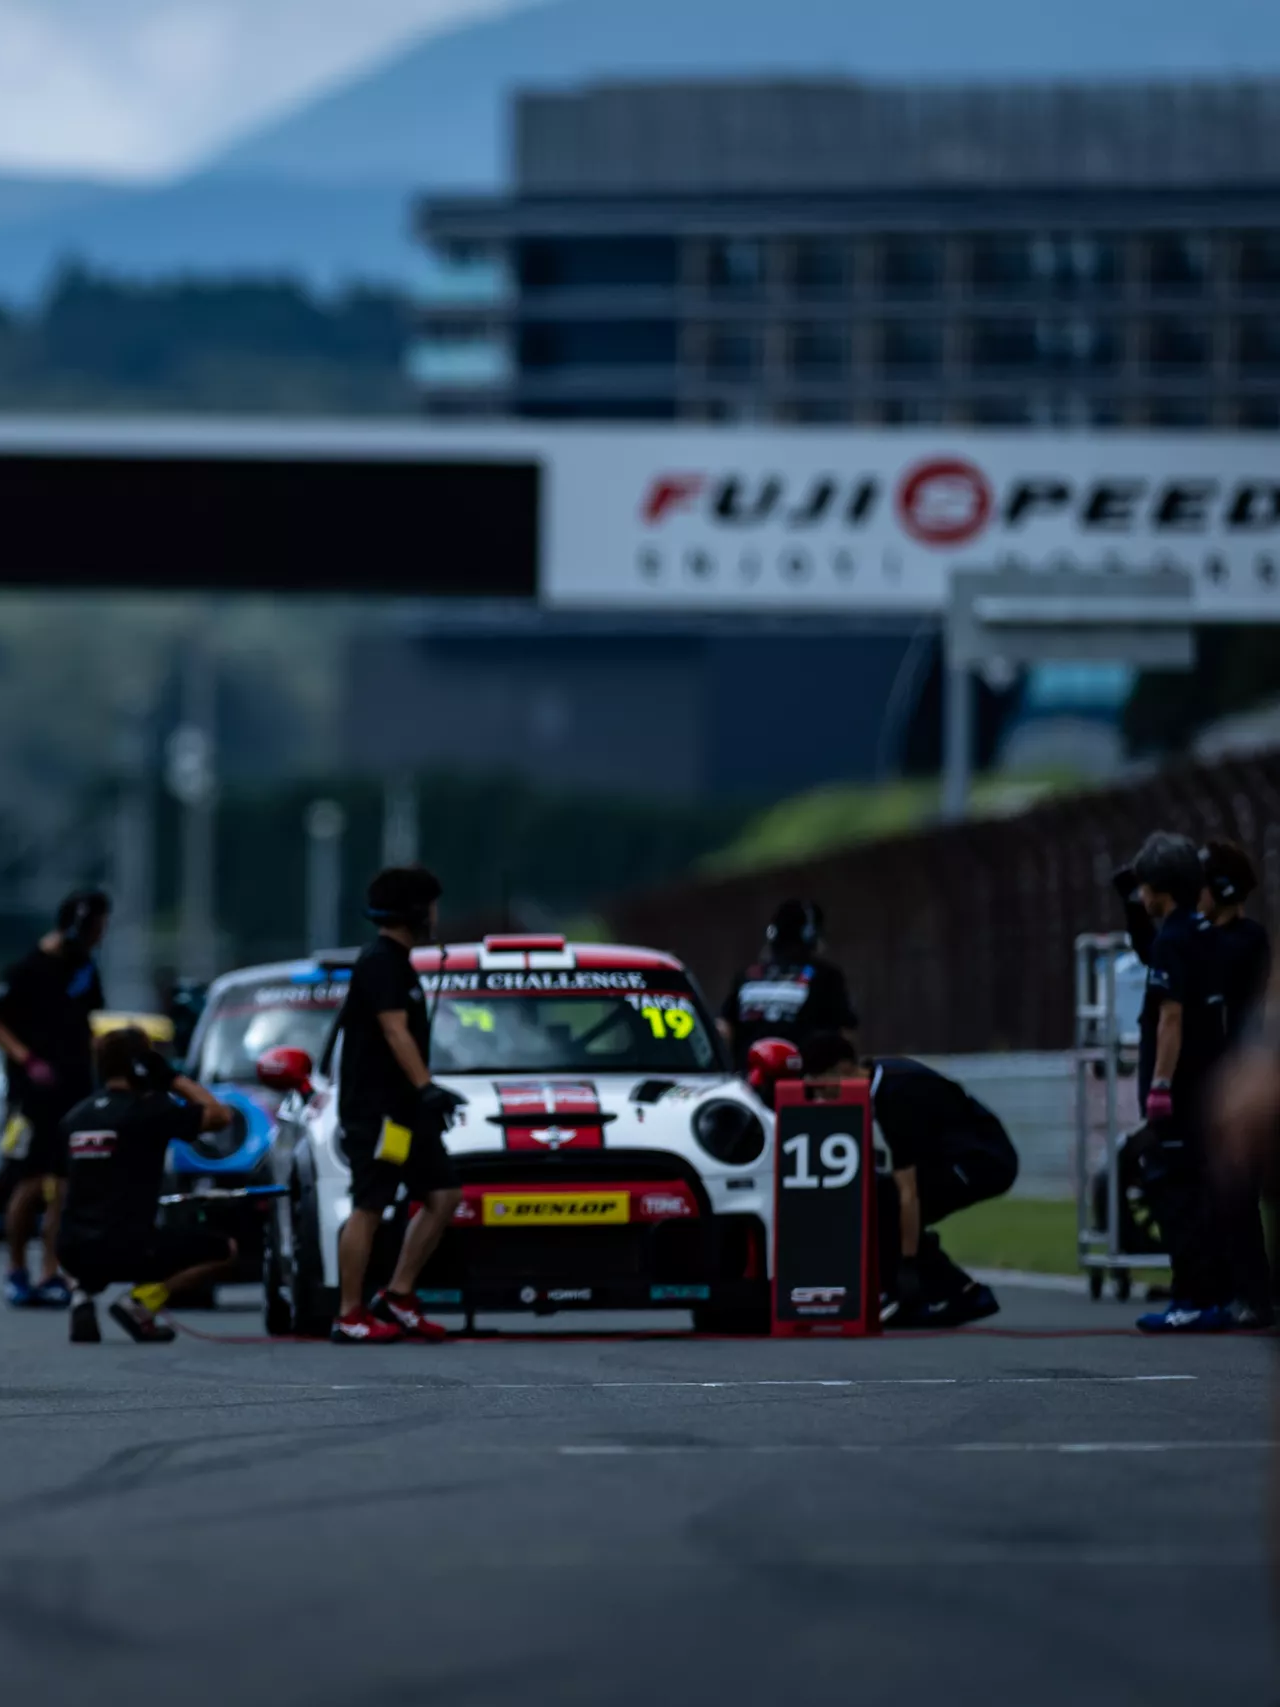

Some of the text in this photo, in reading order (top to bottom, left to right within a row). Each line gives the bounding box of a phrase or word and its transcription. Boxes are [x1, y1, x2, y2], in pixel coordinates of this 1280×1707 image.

[638, 471, 882, 528] FUJI
[641, 1007, 694, 1039] 19
[782, 1132, 861, 1189] 19
[514, 1201, 617, 1217] DUNLOP
